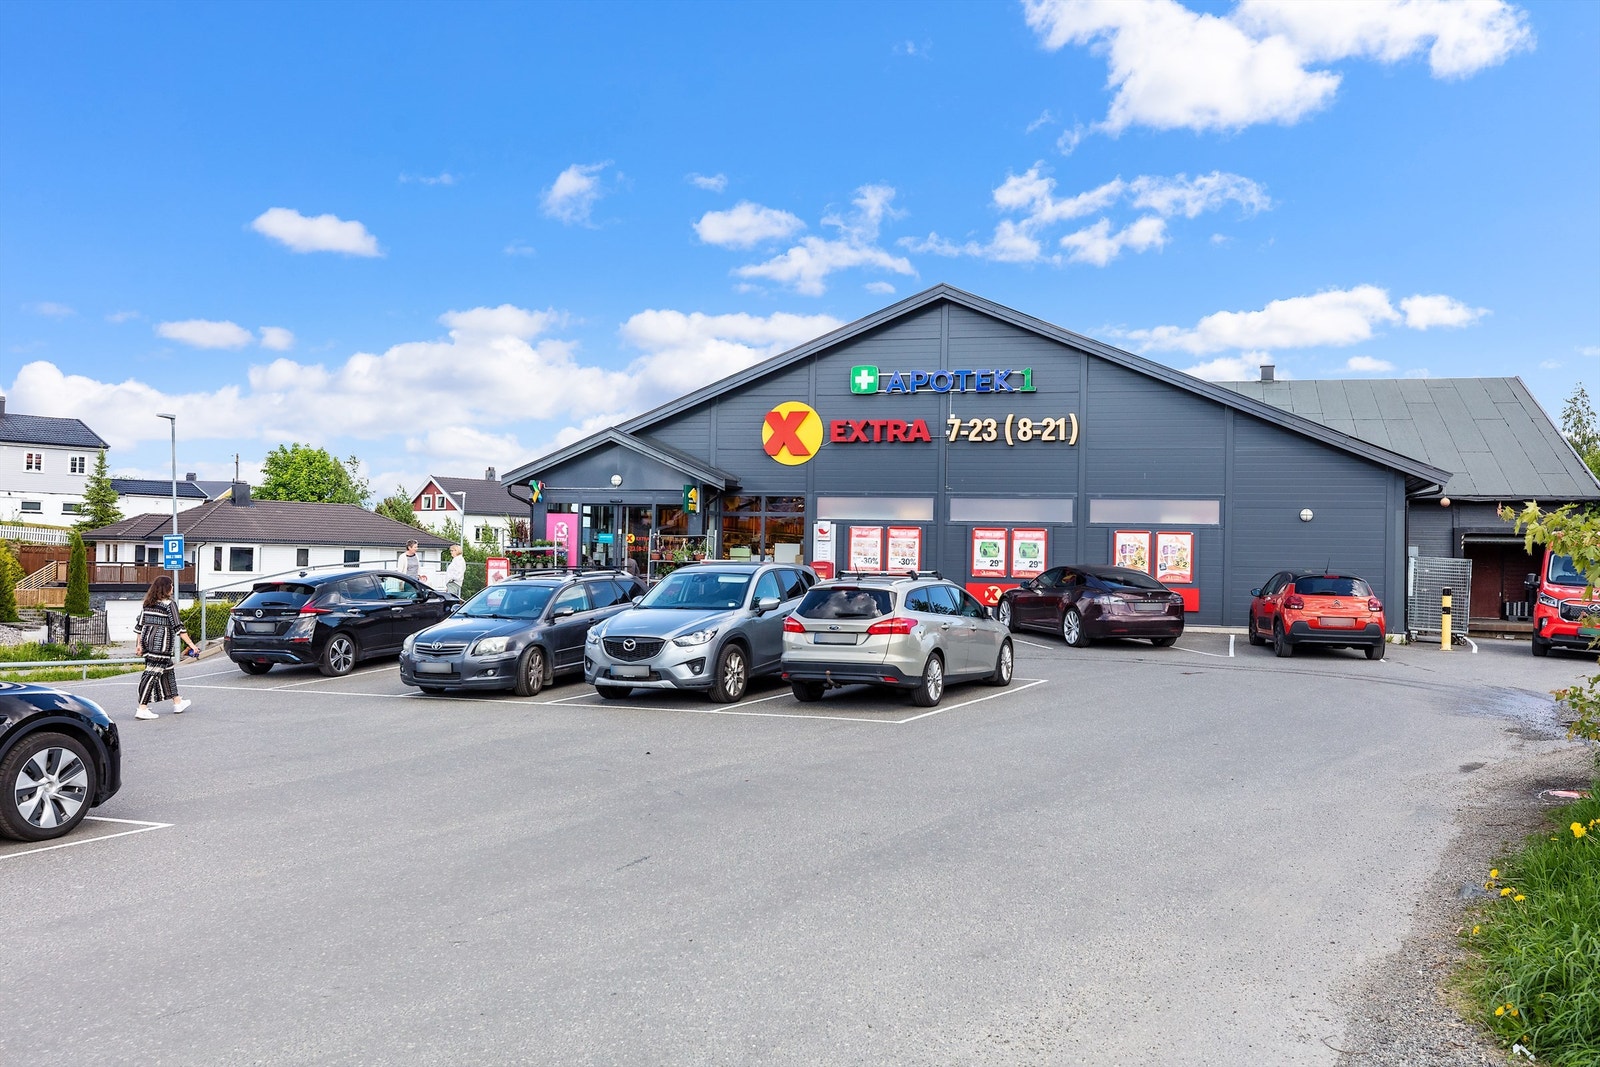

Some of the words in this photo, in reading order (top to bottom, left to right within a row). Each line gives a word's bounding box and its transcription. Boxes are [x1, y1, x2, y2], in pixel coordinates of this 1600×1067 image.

[885, 369, 1014, 393] APOTEK
[763, 411, 811, 456] X
[830, 419, 932, 443] EXTRA
[947, 418, 998, 442] 7-23
[1004, 413, 1078, 446] (8-21)
[171, 542, 177, 551] P
[898, 558, 917, 566] -30%
